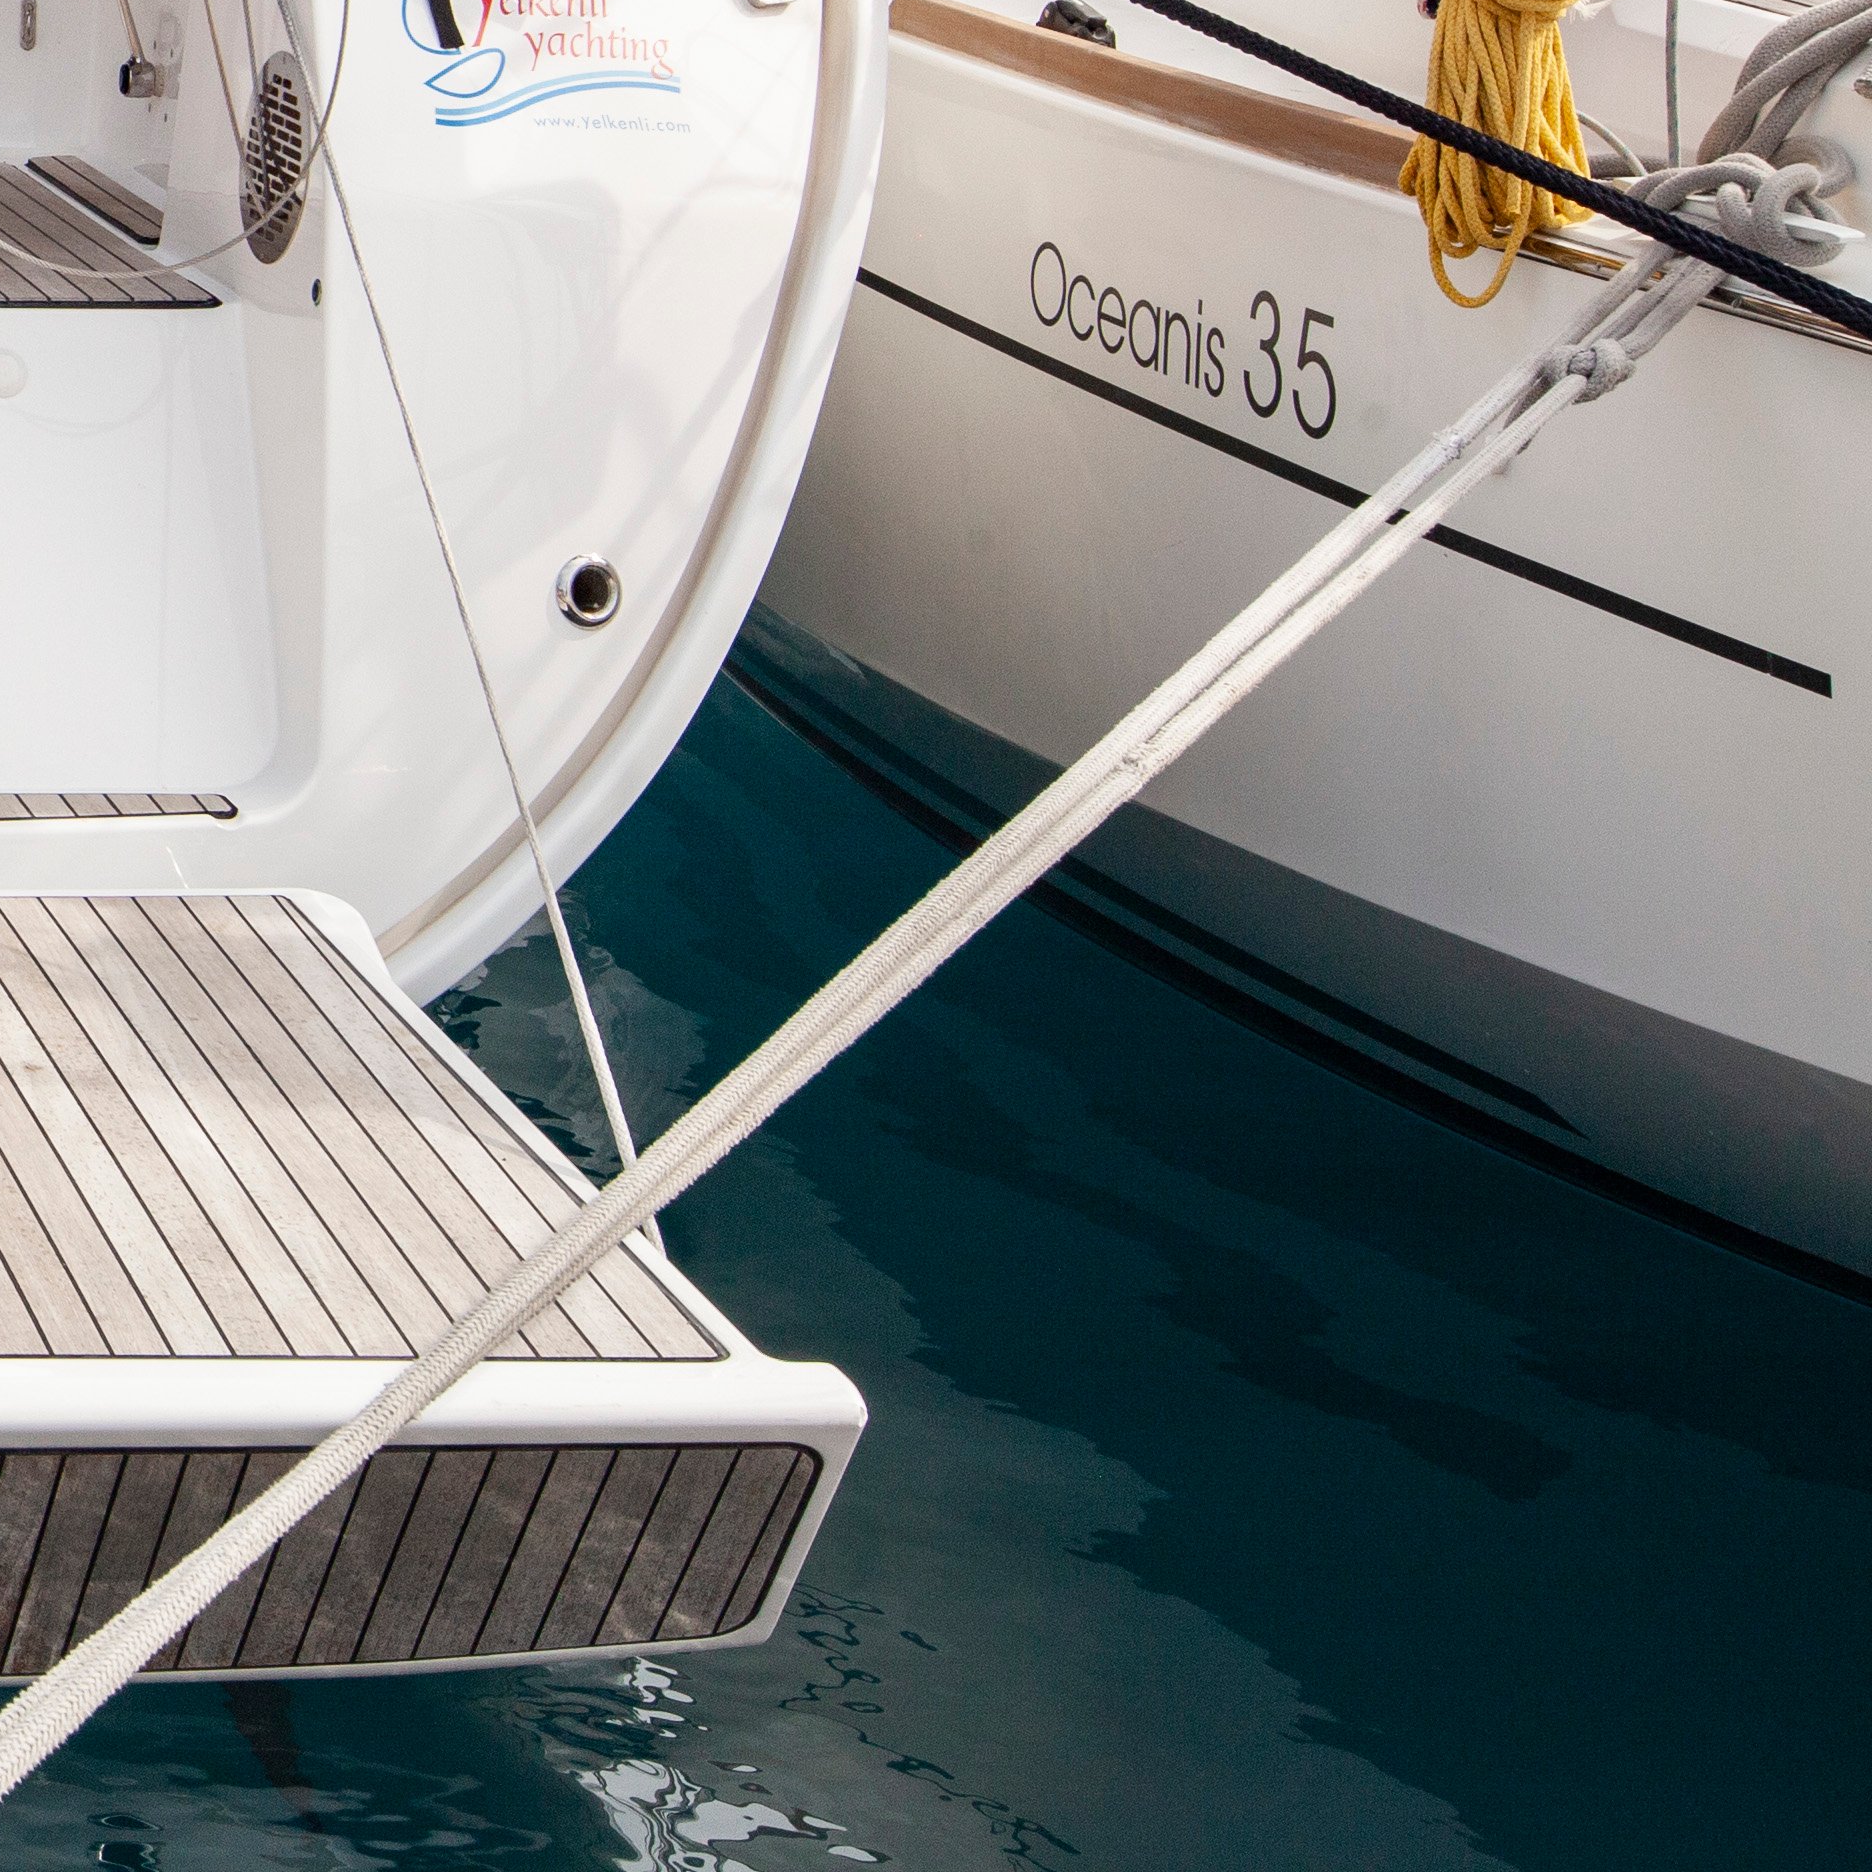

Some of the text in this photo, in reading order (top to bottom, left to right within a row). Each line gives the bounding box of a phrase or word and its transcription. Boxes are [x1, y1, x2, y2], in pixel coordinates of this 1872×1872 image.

[523, 21, 675, 81] yachting
[532, 114, 692, 134] www.Yelkenli.com
[1030, 240, 1337, 440] Oceanis 35
